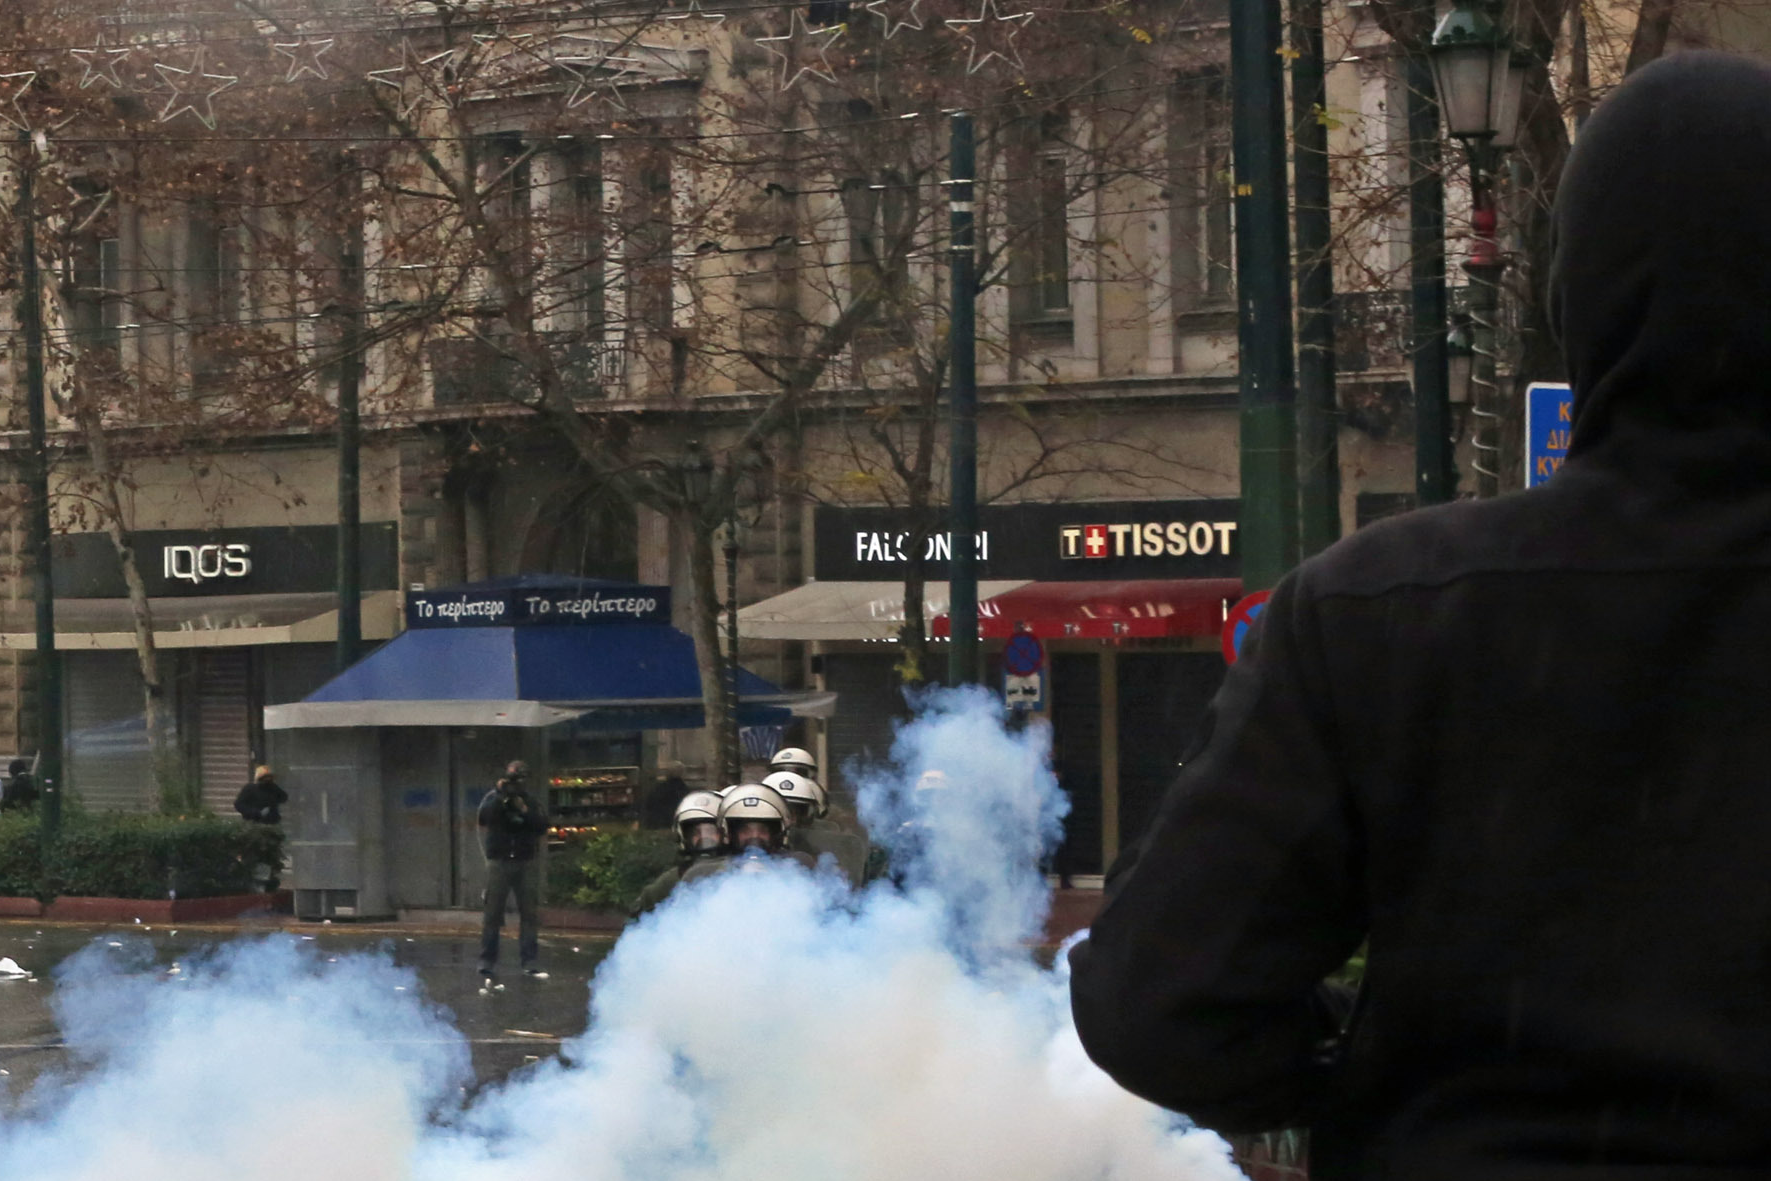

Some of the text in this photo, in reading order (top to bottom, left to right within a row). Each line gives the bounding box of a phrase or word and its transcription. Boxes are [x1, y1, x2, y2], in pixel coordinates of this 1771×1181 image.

[1108, 520, 1237, 557] TISSOT
[162, 543, 252, 585] IQOS
[436, 593, 505, 623] περίπτερο
[555, 591, 657, 620] περίπτερο
